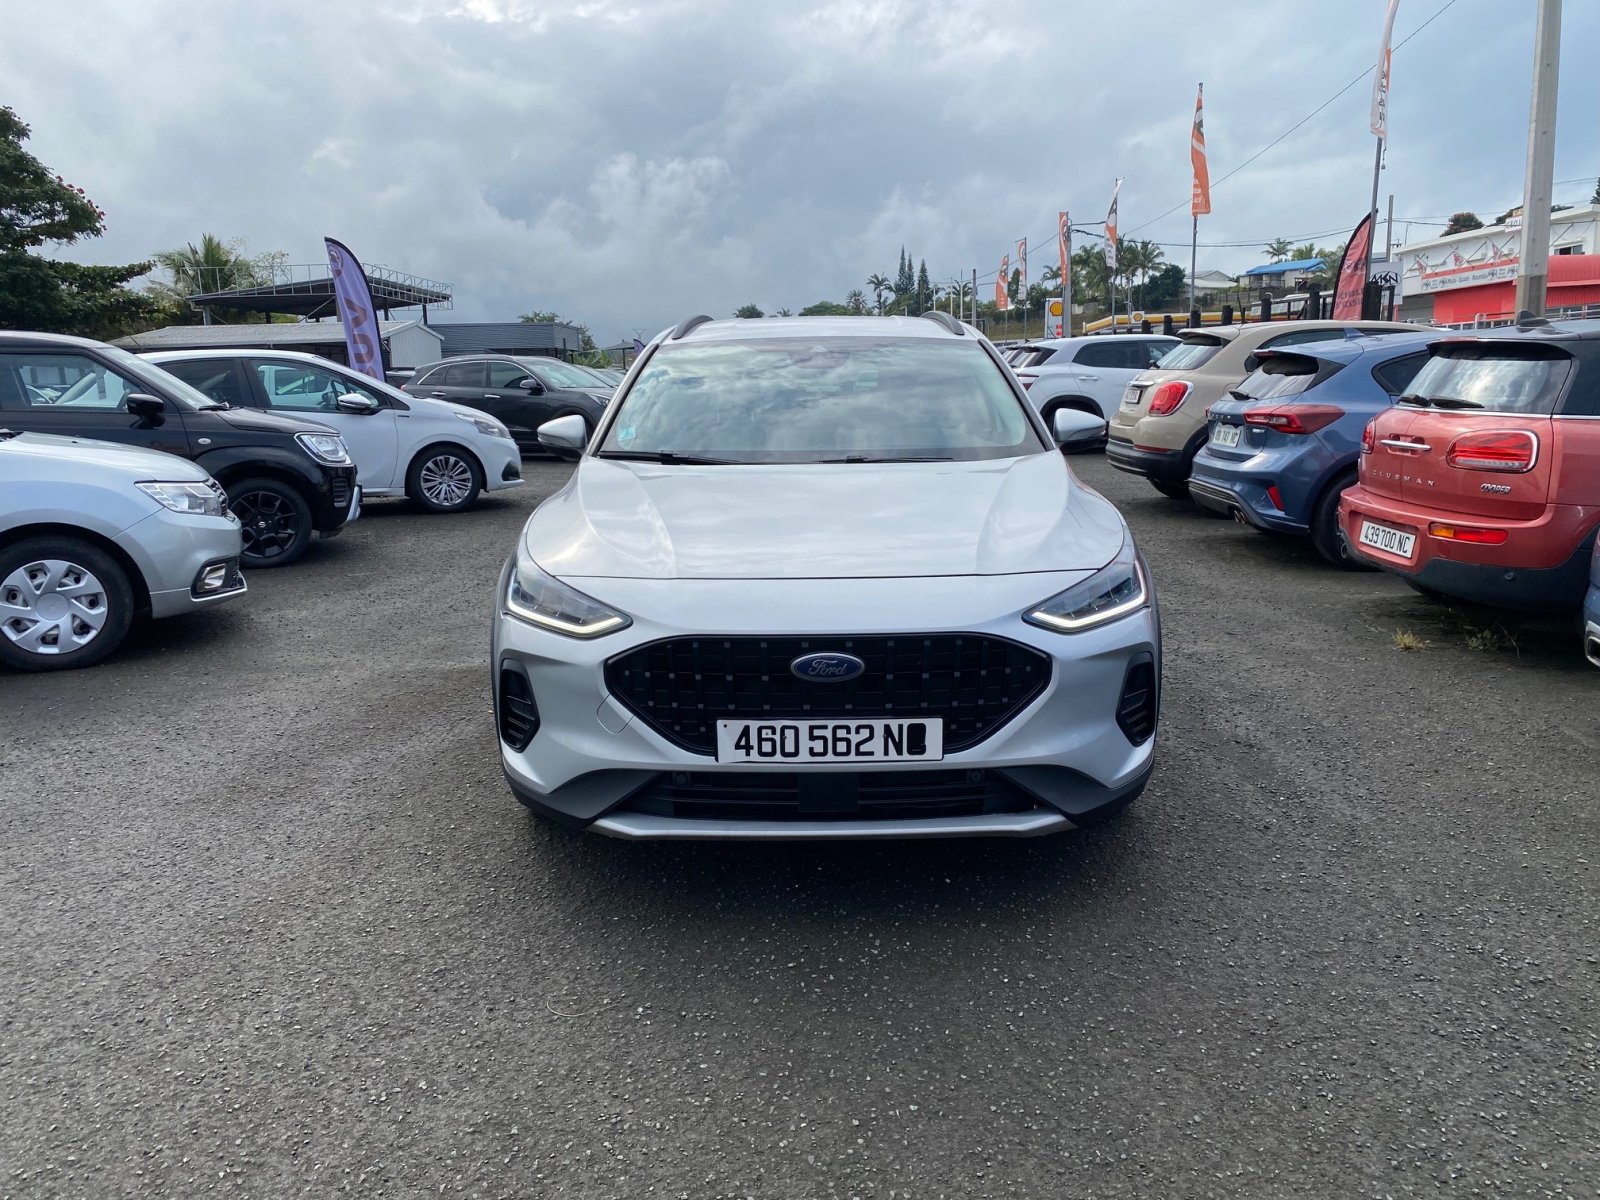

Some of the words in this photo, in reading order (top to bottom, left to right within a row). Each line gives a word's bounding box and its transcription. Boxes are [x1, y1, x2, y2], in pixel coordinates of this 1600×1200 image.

[1373, 469, 1435, 487] CLUBMAN
[1481, 483, 1511, 495] COOPER
[1364, 525, 1380, 544] 439
[1380, 530, 1397, 549] 700
[1396, 534, 1411, 554] NC
[808, 660, 847, 676] Ford
[734, 724, 799, 758] 460
[808, 724, 875, 757] 562
